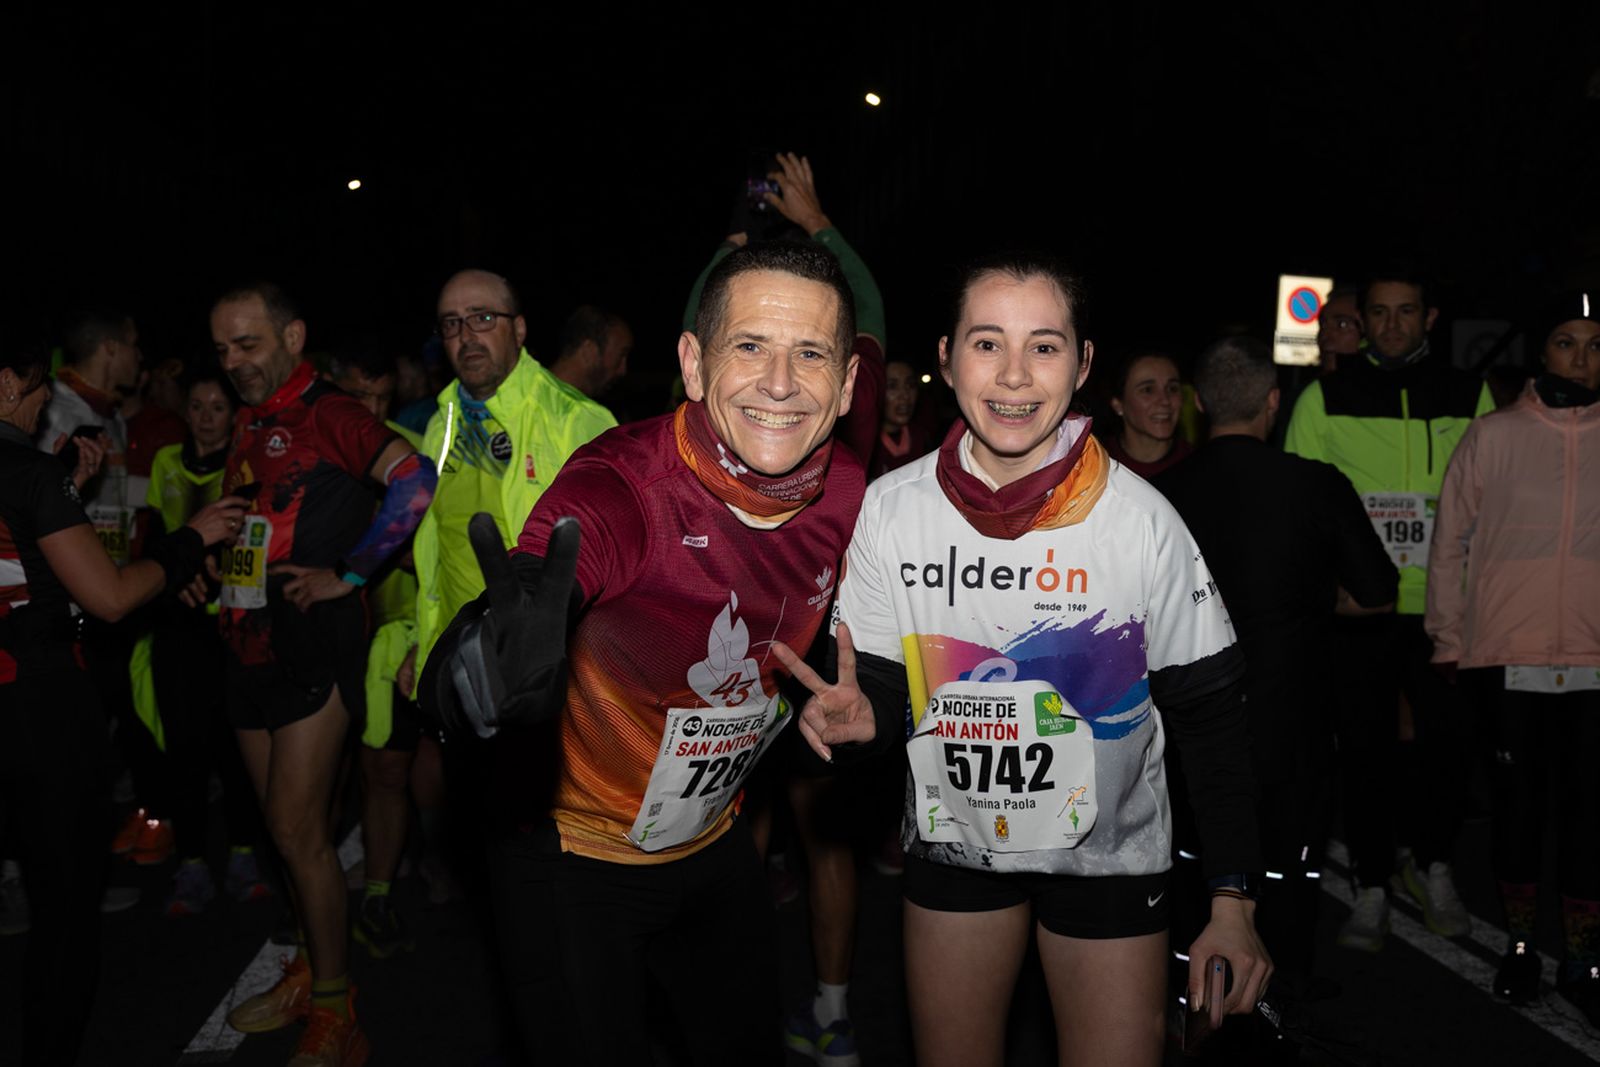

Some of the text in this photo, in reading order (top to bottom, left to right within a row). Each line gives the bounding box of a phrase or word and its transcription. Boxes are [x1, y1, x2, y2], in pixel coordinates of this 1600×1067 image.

[1383, 520, 1424, 543] 198
[901, 545, 1088, 607] calderón
[1034, 602, 1087, 613] desde 1949
[943, 701, 1017, 718] NOCHE DE
[683, 719, 701, 733] 43
[701, 714, 768, 737] NOCHE DE
[928, 719, 1018, 741] AN ANTÓN
[675, 741, 711, 757] SAN
[944, 742, 1055, 794] 5742
[966, 796, 1036, 810] Yanina Paola
